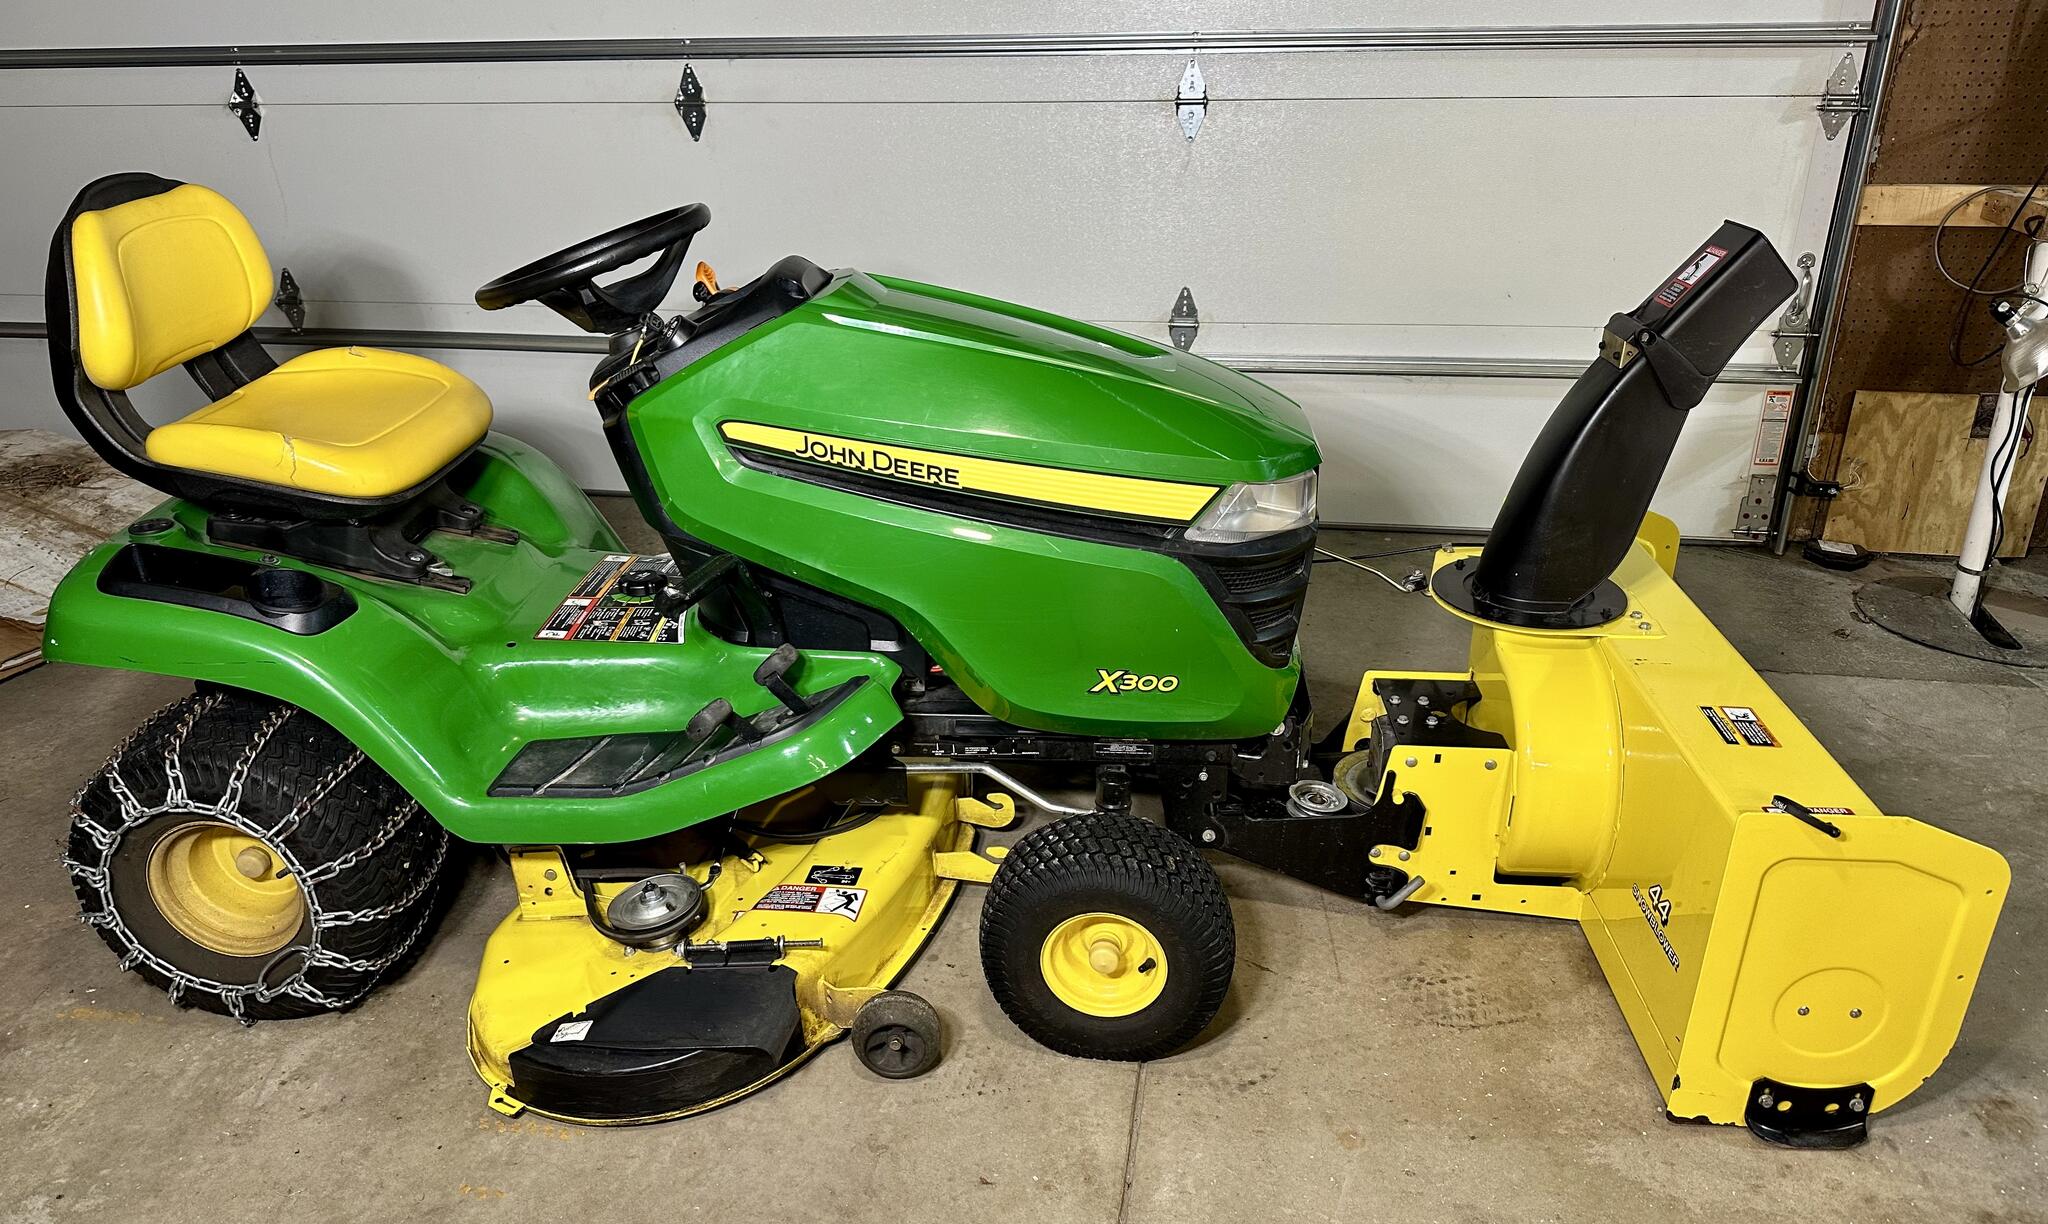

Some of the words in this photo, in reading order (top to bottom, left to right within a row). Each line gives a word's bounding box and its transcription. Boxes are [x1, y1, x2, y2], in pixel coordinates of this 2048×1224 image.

[795, 435, 866, 467] JOHN
[872, 449, 960, 486] DEERE
[1088, 668, 1180, 694] X300
[1632, 884, 1680, 968] SNOWBLOWER
[1649, 885, 1671, 925] 44
